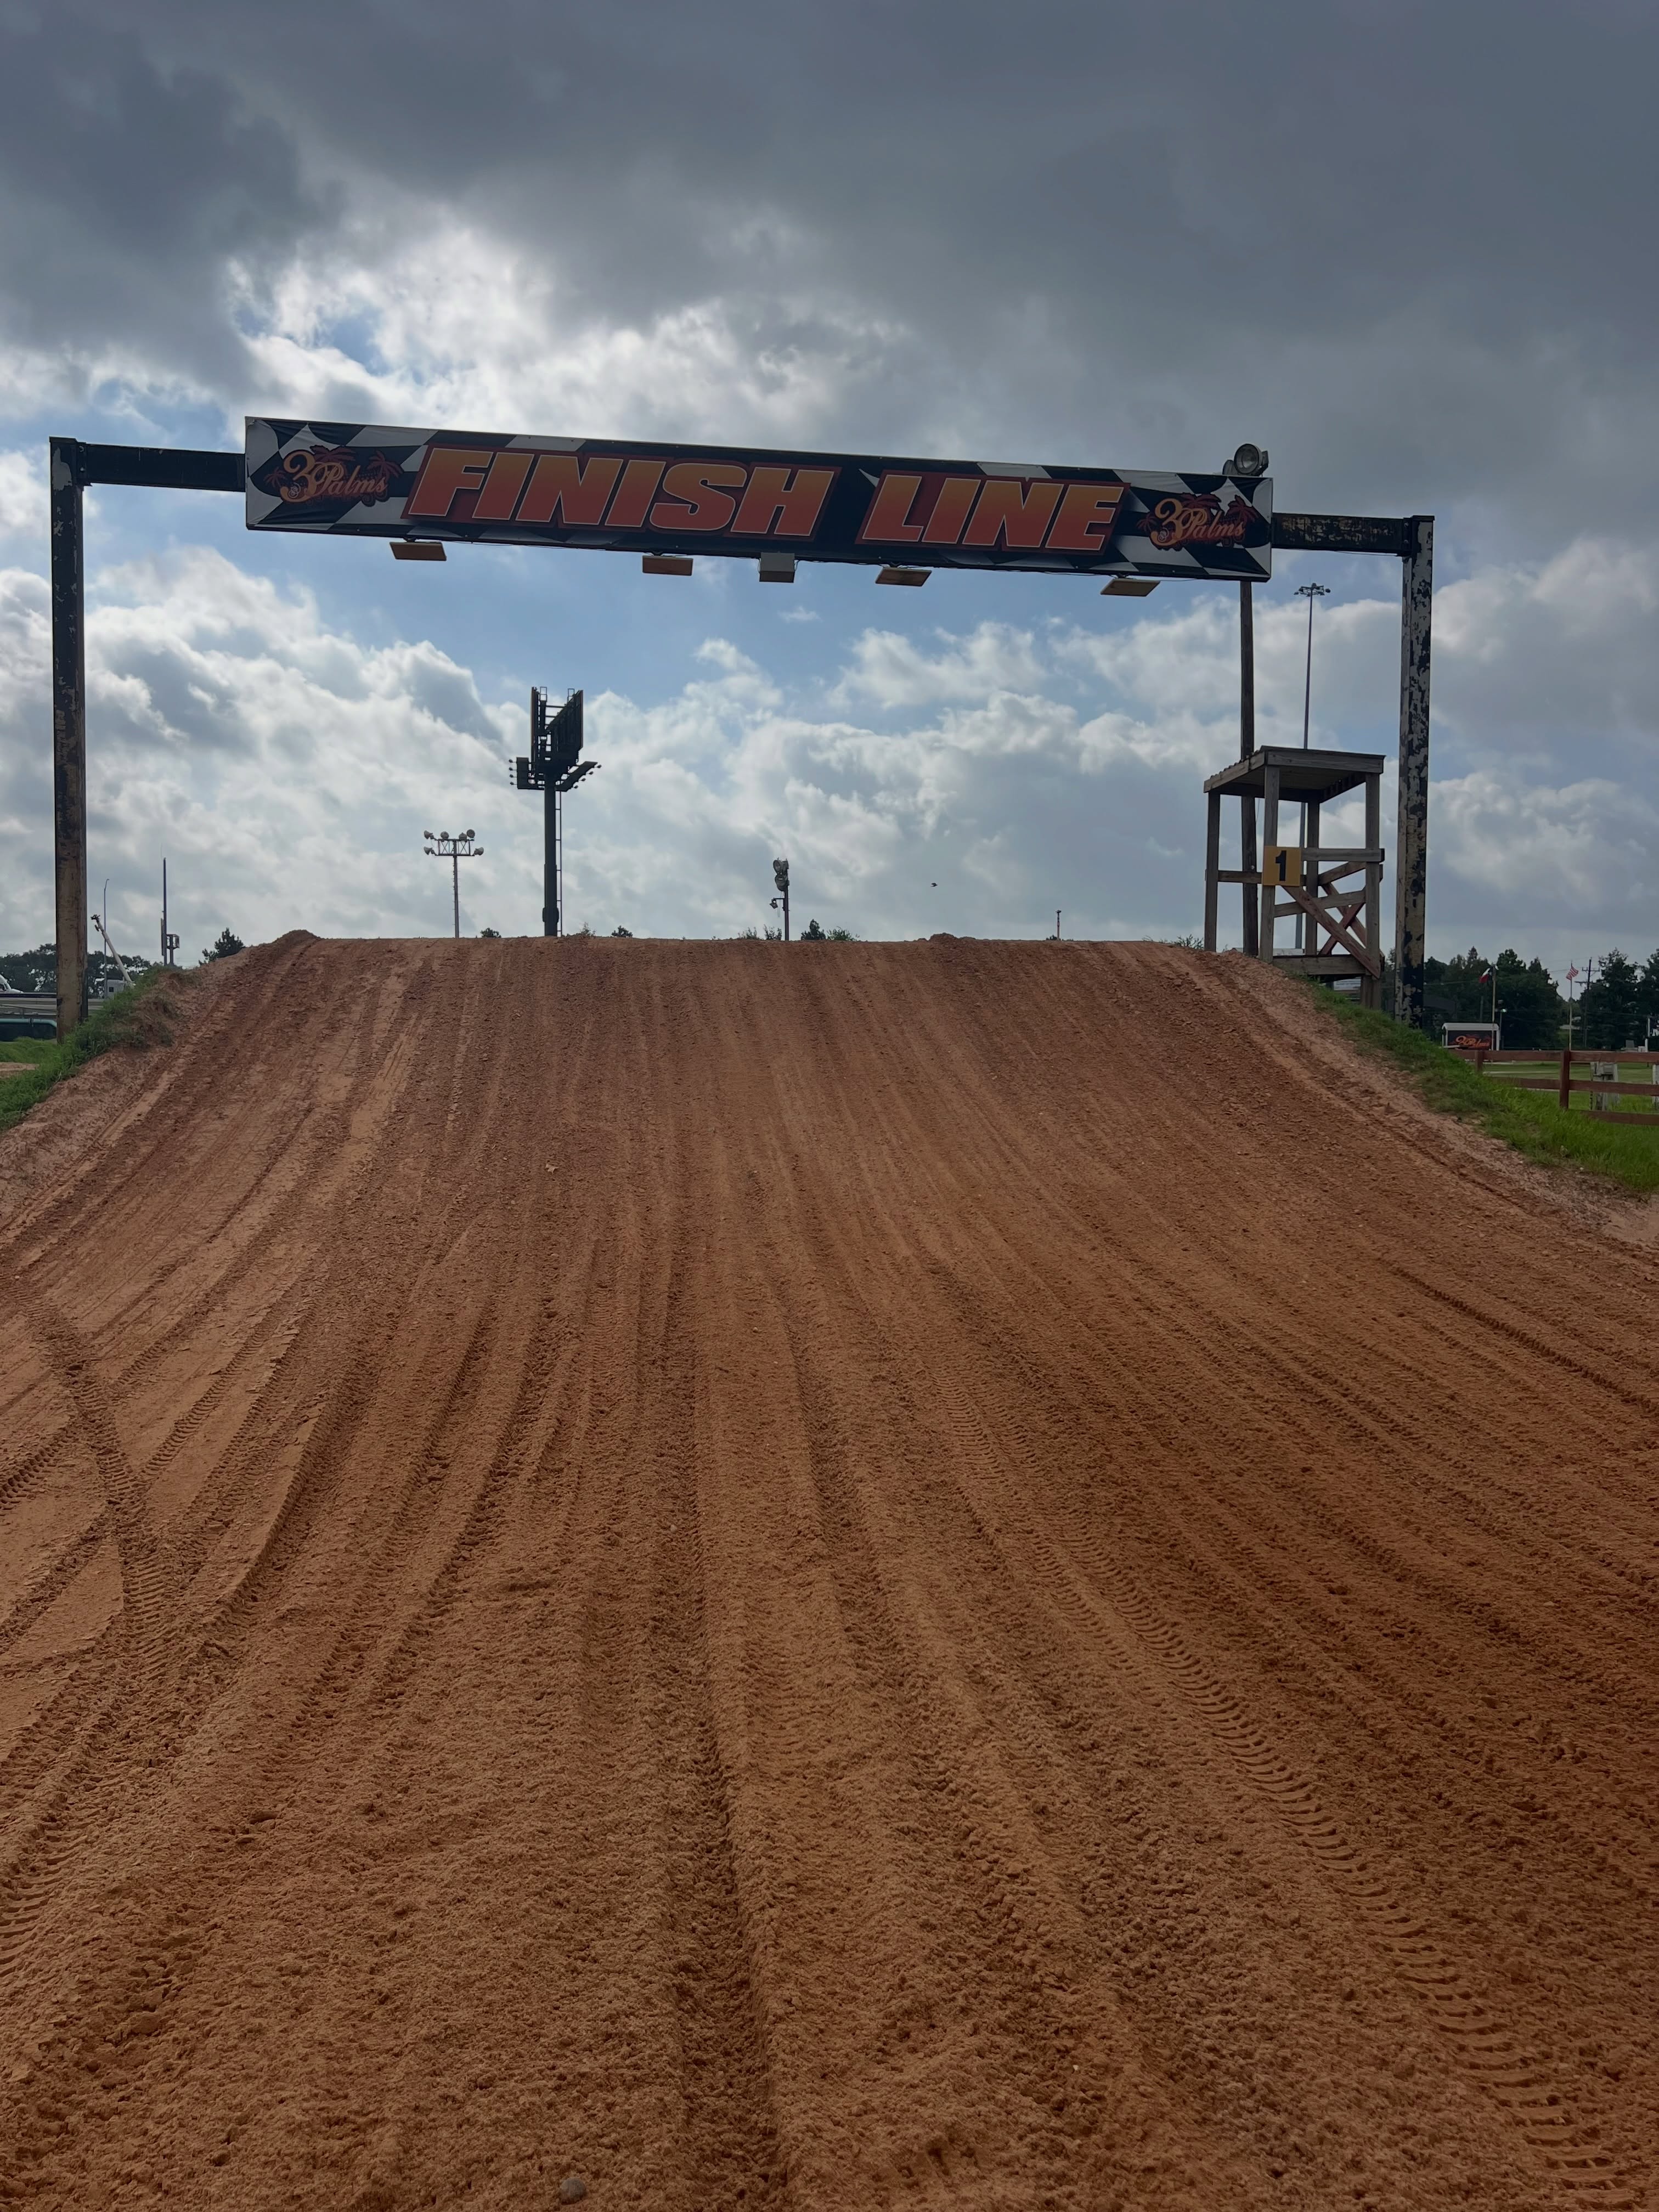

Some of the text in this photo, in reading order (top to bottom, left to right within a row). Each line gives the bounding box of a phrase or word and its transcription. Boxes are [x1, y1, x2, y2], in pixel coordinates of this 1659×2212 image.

[280, 450, 388, 503] 3 Palms
[408, 447, 1124, 550] FINISH LINE
[1150, 498, 1245, 546] 3 Palms
[1276, 850, 1287, 881] 1
